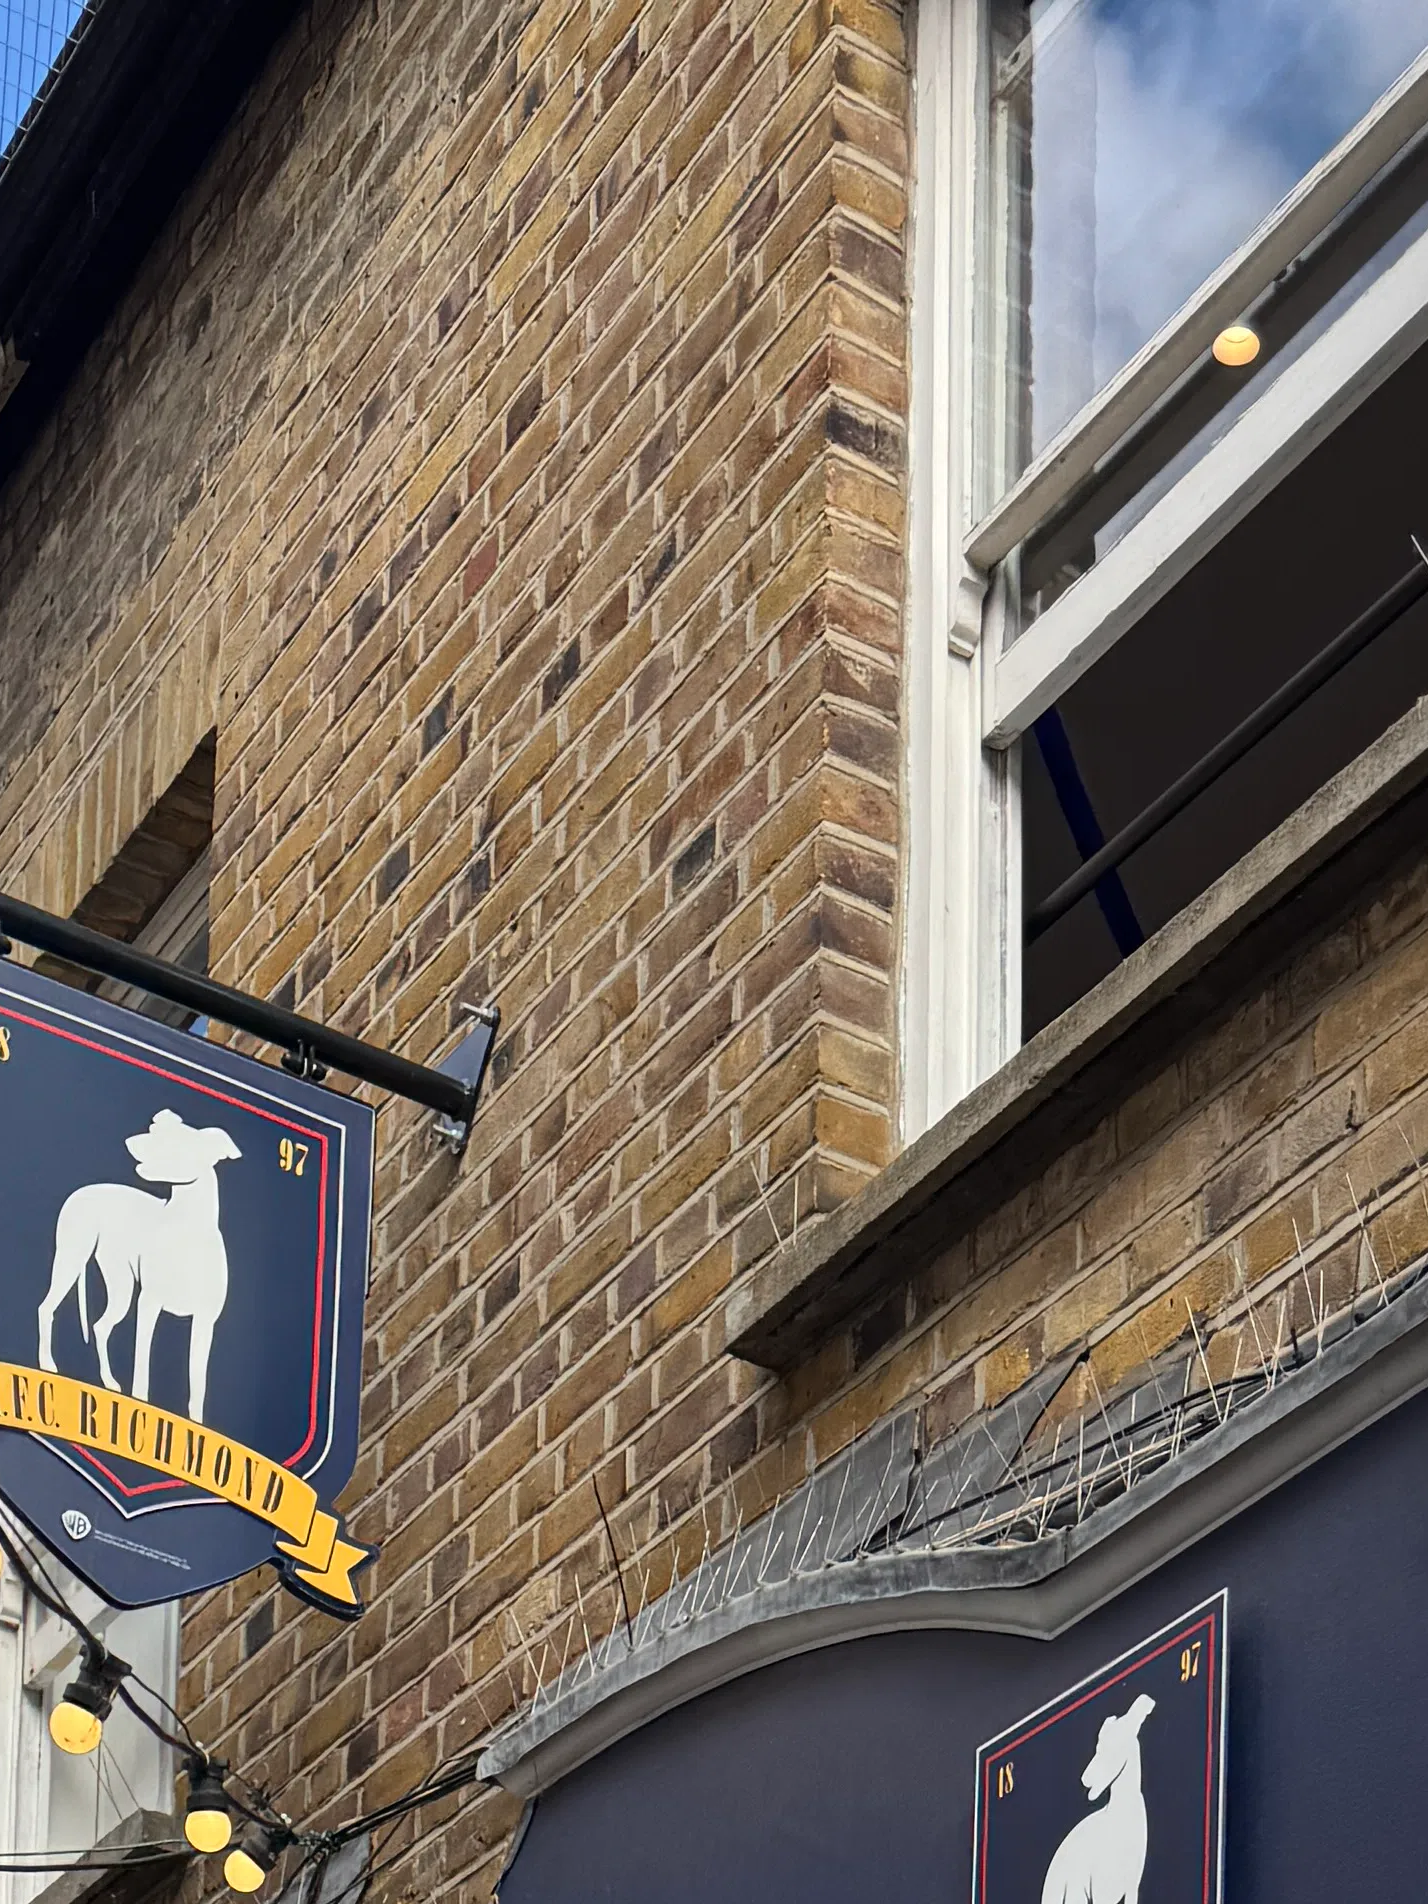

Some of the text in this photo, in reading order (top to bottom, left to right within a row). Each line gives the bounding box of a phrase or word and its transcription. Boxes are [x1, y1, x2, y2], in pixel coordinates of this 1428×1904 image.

[279, 1137, 309, 1176] 97
[79, 1389, 285, 1514] RICHMOND
[1180, 1640, 1202, 1682] 97
[997, 1761, 1014, 1799] 18
